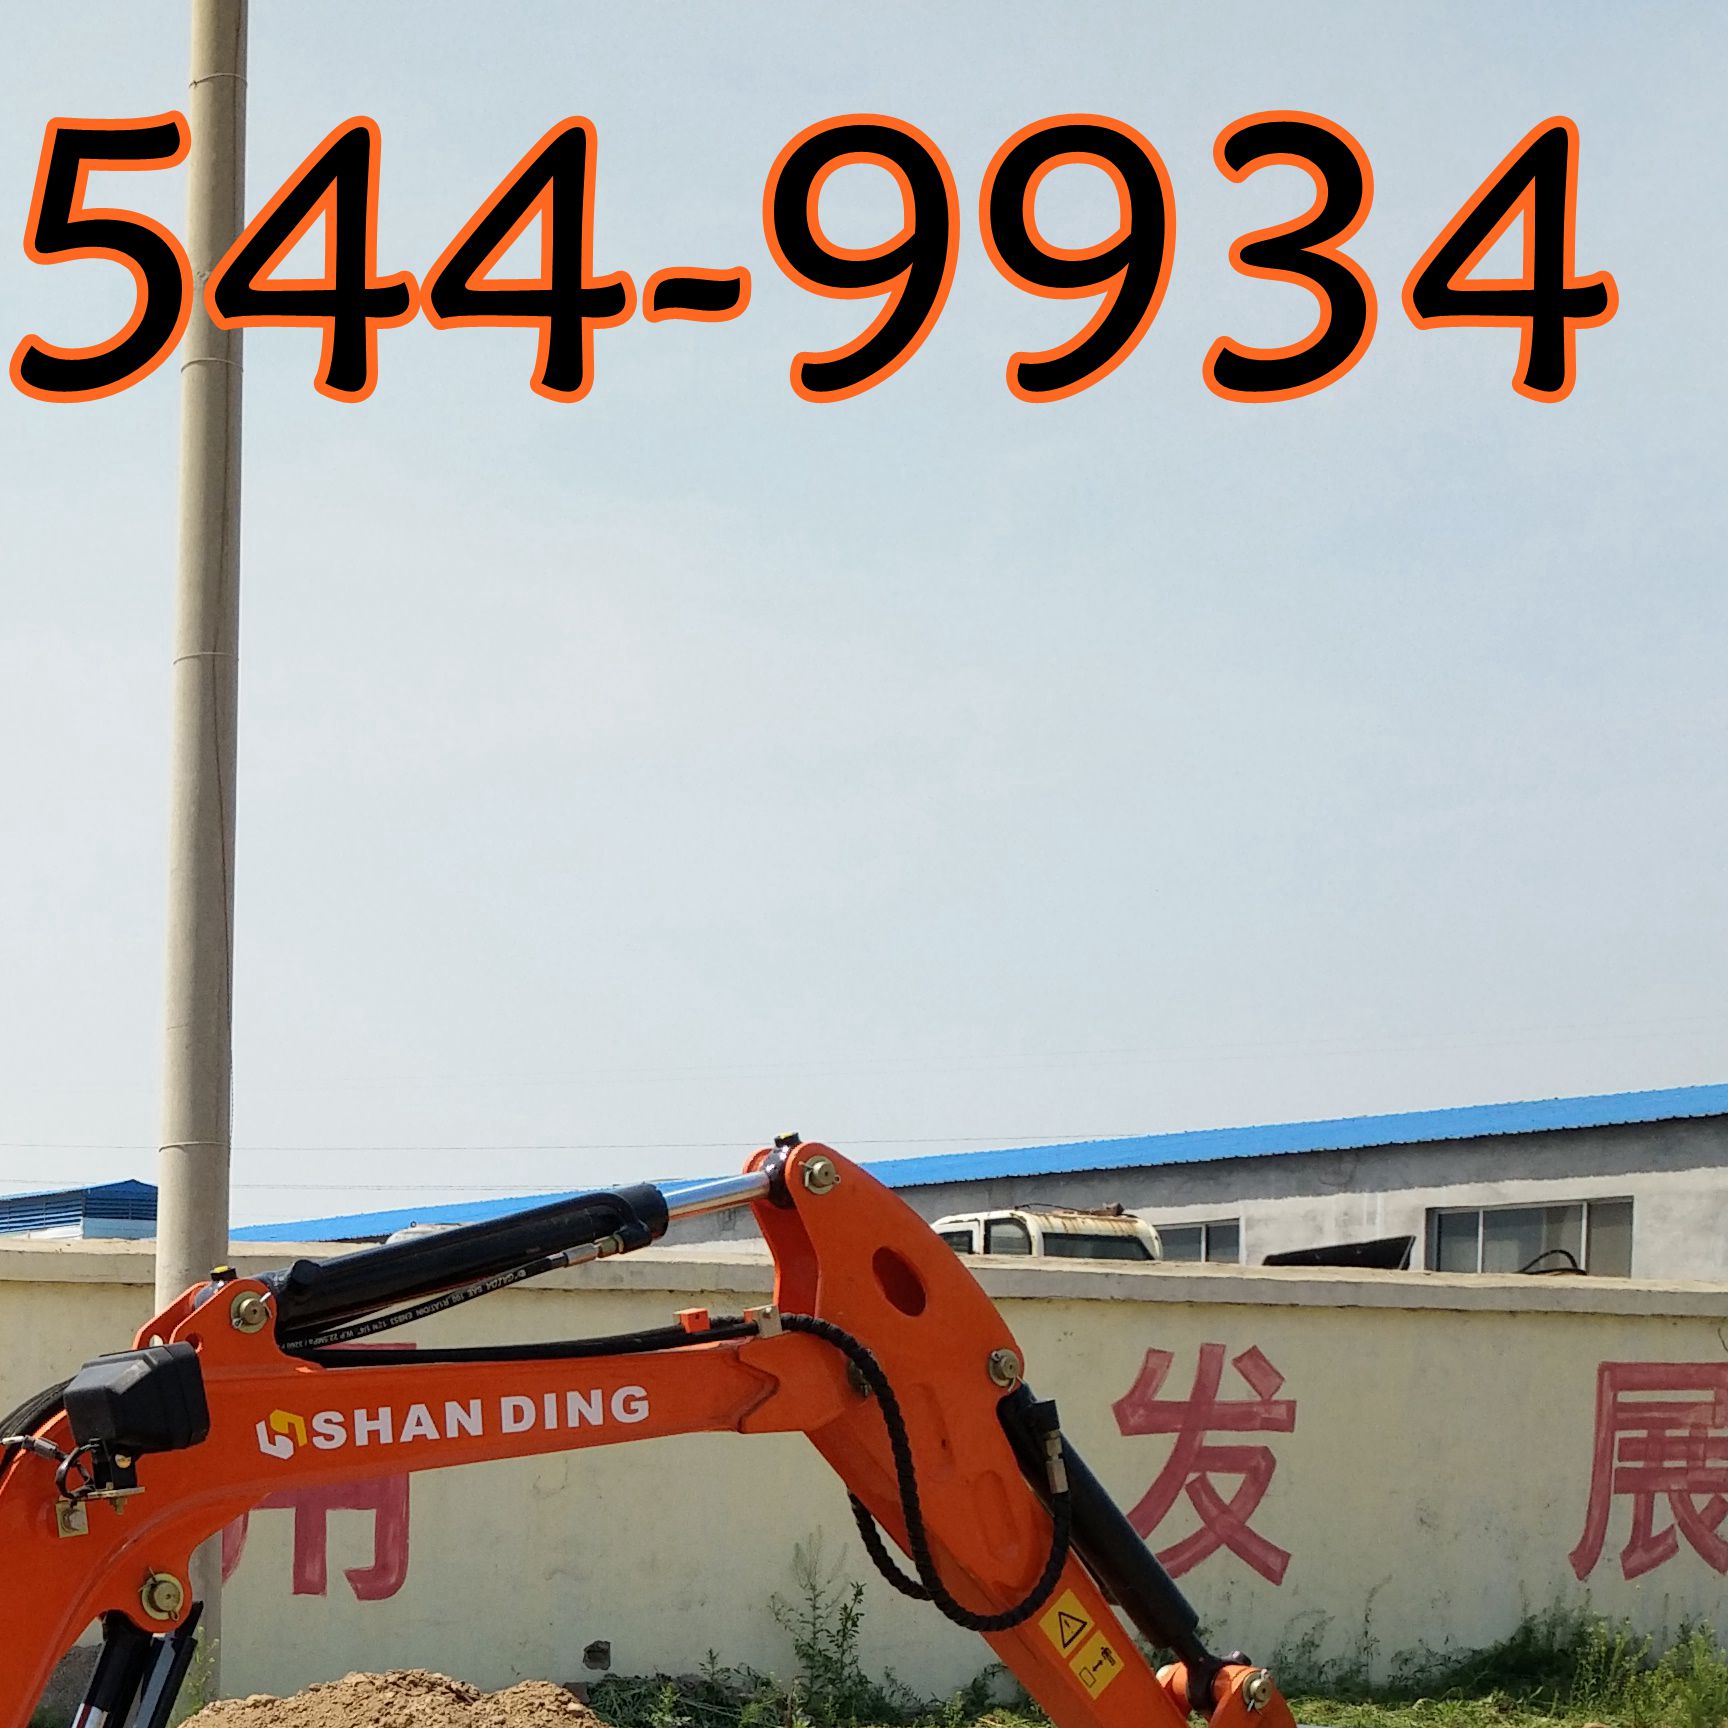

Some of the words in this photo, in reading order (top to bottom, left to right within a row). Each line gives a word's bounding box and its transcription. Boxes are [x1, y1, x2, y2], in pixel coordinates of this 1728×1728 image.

[312, 1398, 483, 1451] SHAN
[500, 1385, 650, 1435] DING
[1112, 1343, 1297, 1586] 发
